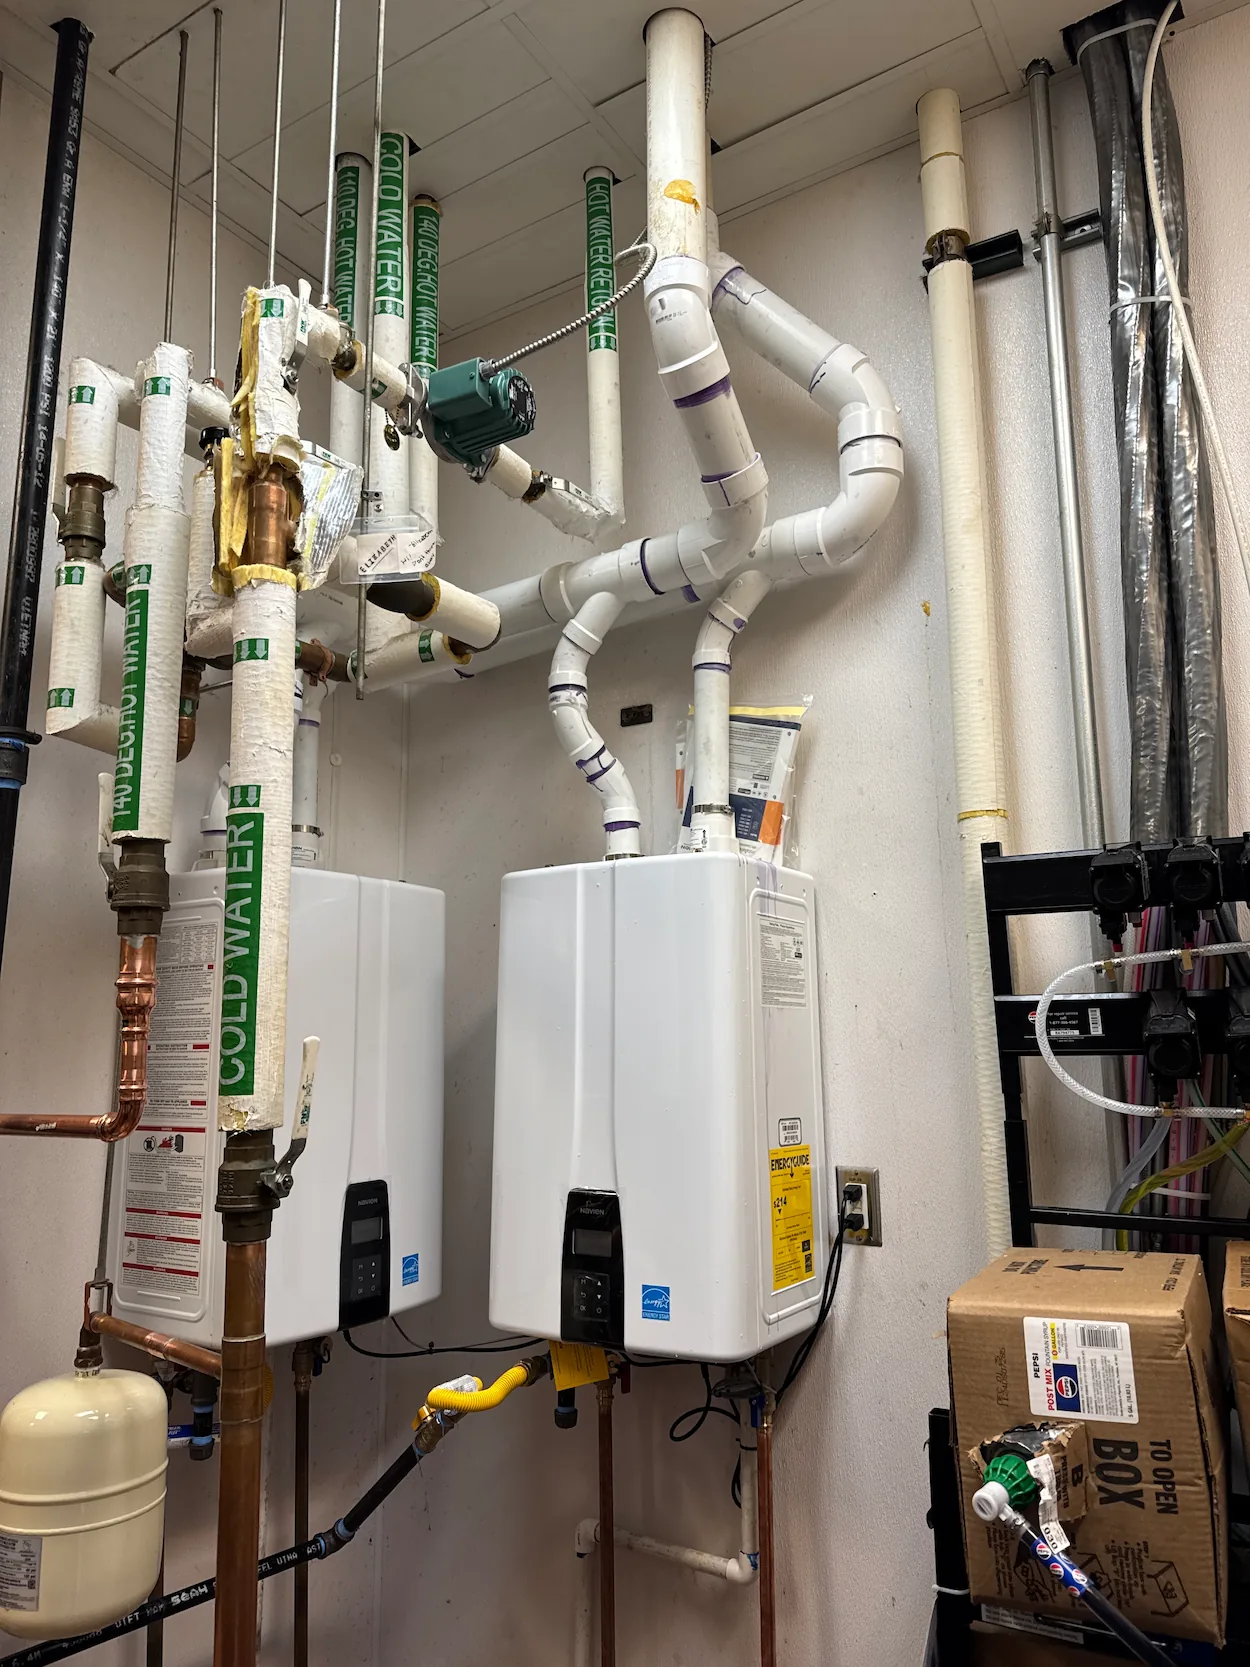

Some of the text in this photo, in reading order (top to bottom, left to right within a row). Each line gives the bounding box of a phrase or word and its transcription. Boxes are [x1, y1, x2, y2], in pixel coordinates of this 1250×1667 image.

[588, 184, 609, 213] HOT
[376, 136, 403, 294] COLD WATER
[418, 215, 438, 239] 140
[335, 237, 354, 270] HOT
[588, 215, 612, 266] WATER
[414, 306, 436, 363] WATER
[360, 534, 396, 572] ELIZABETH
[122, 598, 141, 680] WATER
[113, 782, 132, 816] 140
[218, 820, 256, 1086] COLD WATER
[771, 1154, 810, 1173] ENERGYGUIDE
[1032, 1352, 1040, 1378] PEPSI
[1043, 1339, 1051, 1366] FOUNTAIN
[1044, 1368, 1052, 1385] MIX
[1046, 1387, 1055, 1411] POST
[1072, 1464, 1083, 1487] B
[1092, 1438, 1145, 1510] BOX
[1150, 1439, 1178, 1514] TO OPEN
[306, 1542, 321, 1555] AST
[1044, 1526, 1058, 1550] 030
